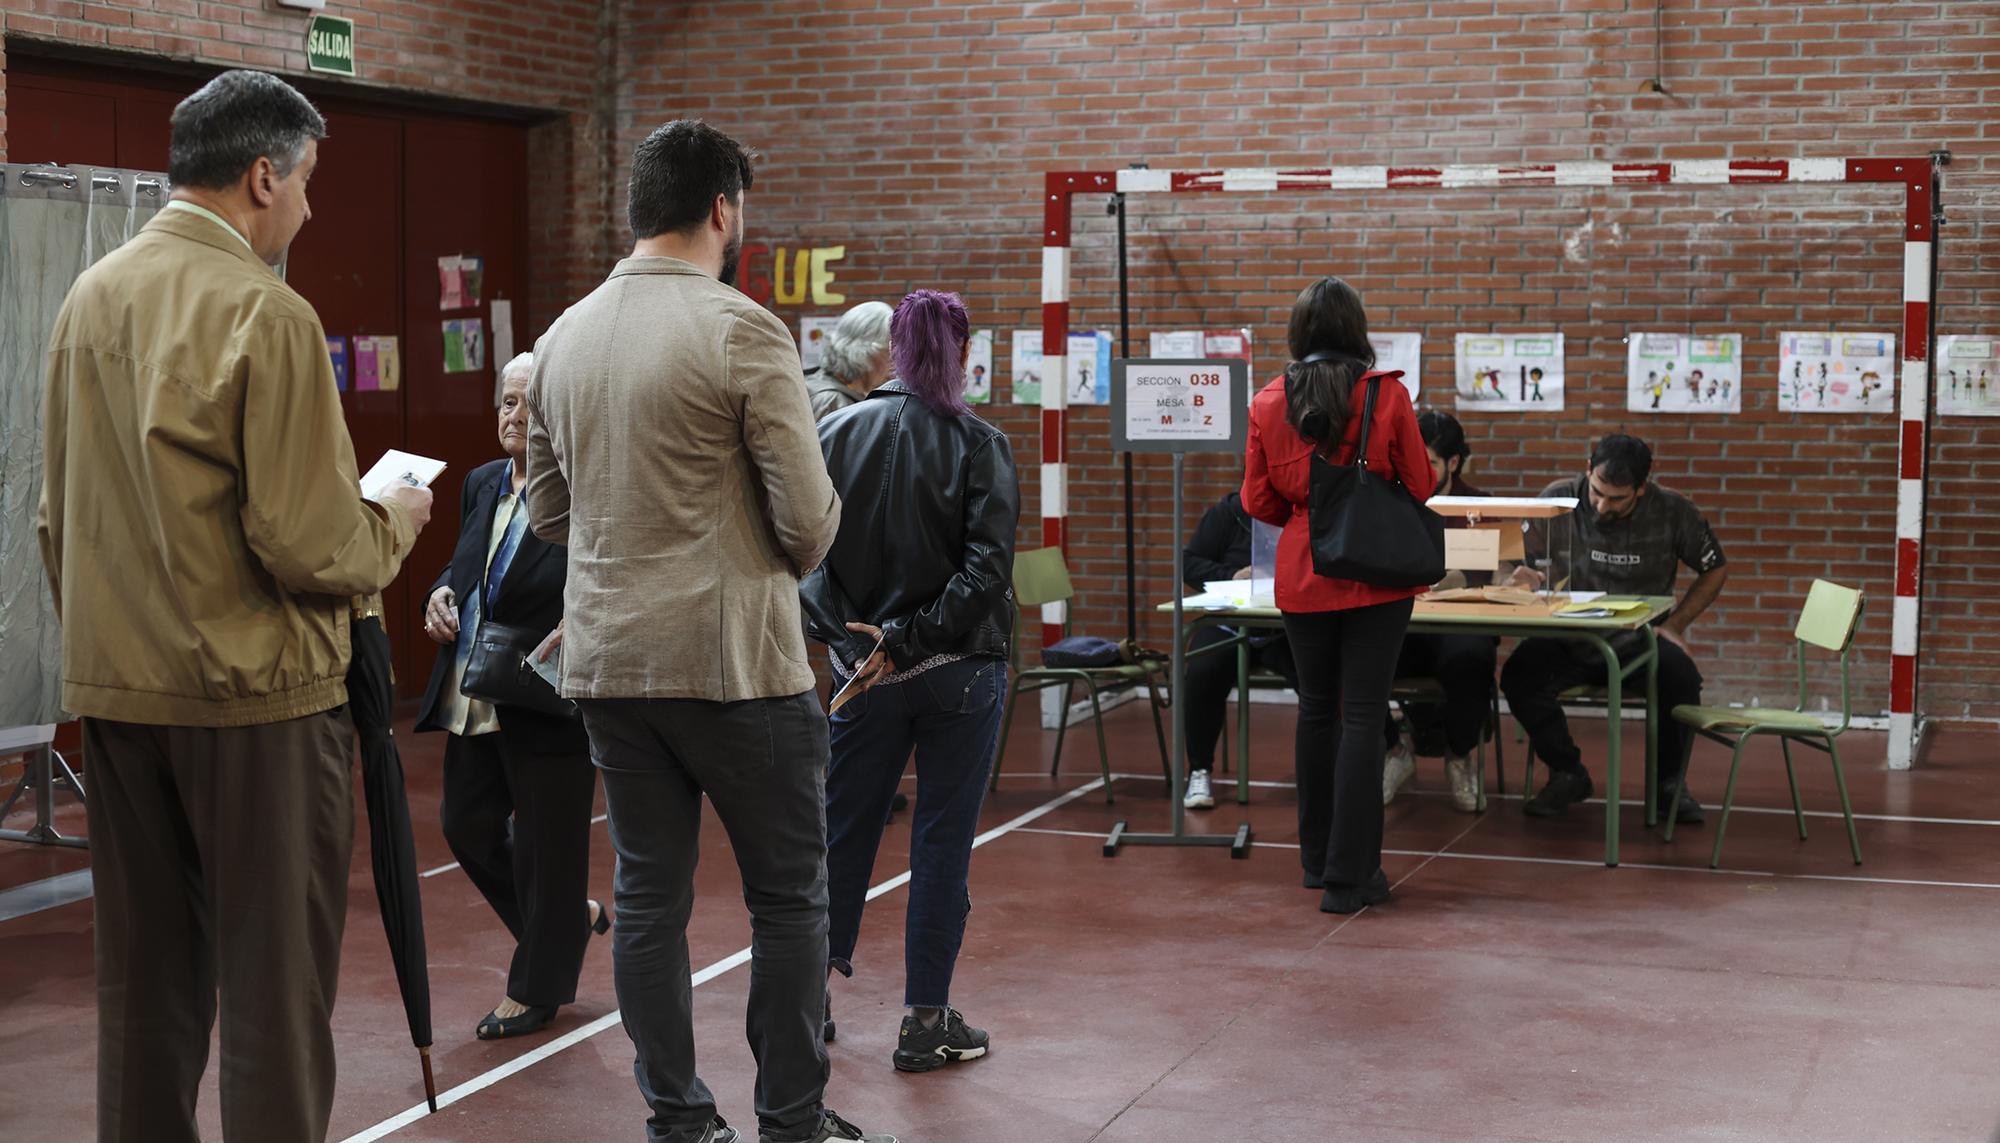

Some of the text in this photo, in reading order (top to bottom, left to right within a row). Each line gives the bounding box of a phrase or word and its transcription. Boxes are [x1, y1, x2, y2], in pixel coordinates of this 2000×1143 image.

[310, 30, 351, 60] SALIDA
[1136, 373, 1220, 386] SECCIÓN 038
[1156, 395, 1204, 408] MESA B
[1161, 415, 1172, 425] M
[1203, 415, 1213, 425] Z
